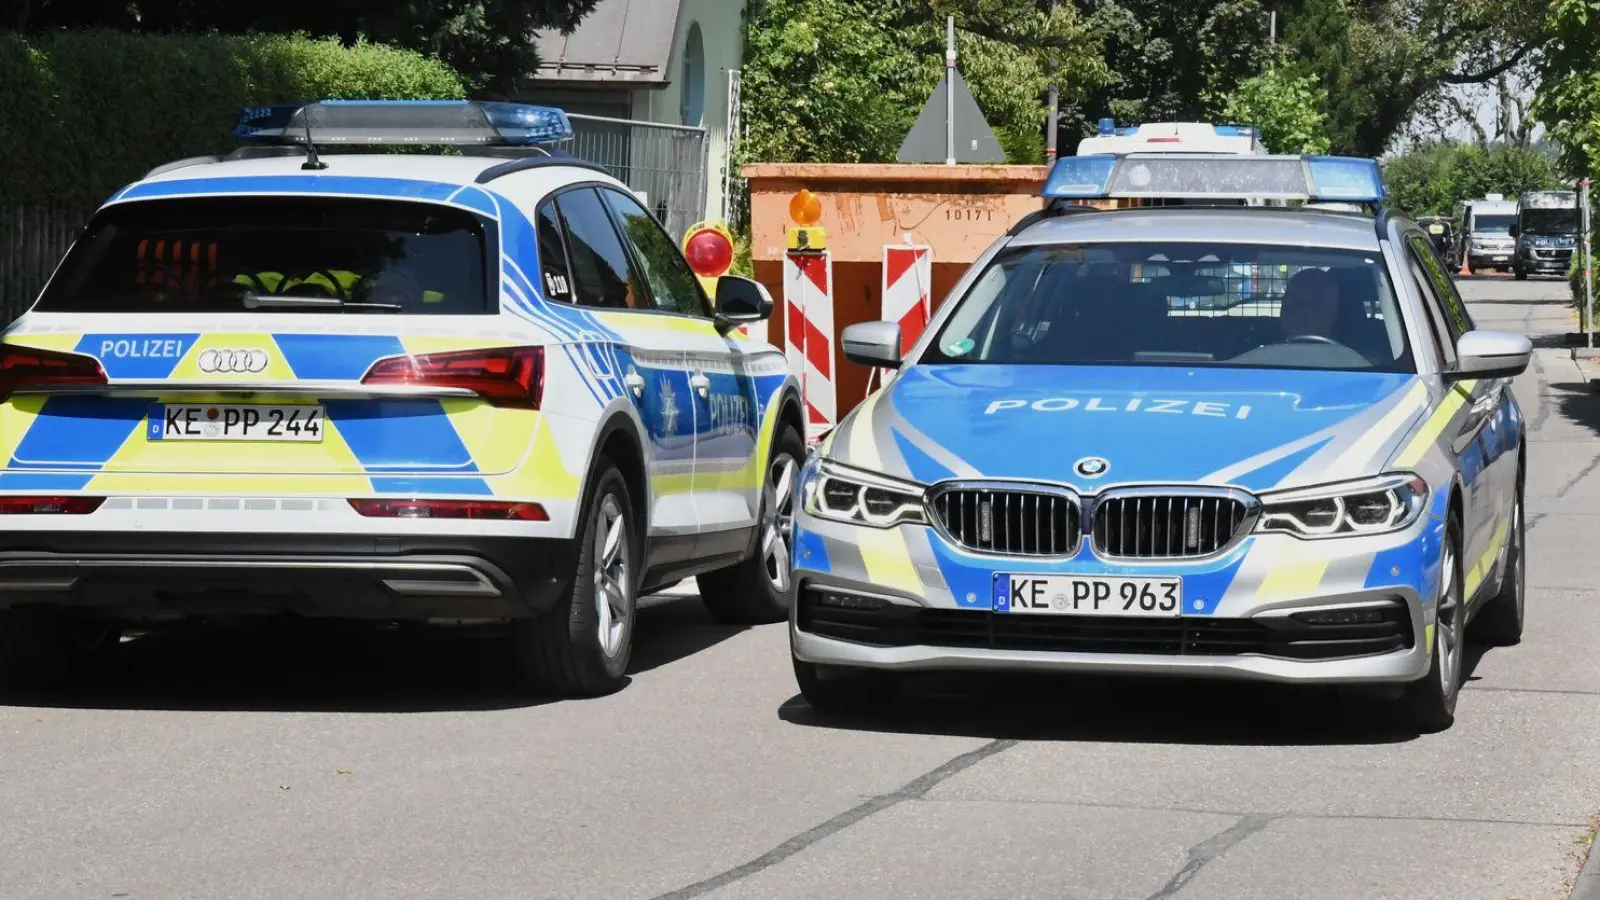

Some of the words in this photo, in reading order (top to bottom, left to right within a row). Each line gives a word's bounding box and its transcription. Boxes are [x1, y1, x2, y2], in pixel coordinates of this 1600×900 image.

[946, 209, 991, 221] 10171
[101, 340, 182, 358] POLIZEI
[984, 397, 1252, 420] POLIZEI
[152, 425, 159, 433] D
[166, 408, 201, 435] KE
[223, 409, 260, 435] PP
[267, 409, 319, 436] 244
[998, 596, 1006, 606] D
[1011, 580, 1049, 608] KE
[1072, 581, 1110, 610] PP
[1119, 582, 1178, 612] 963
